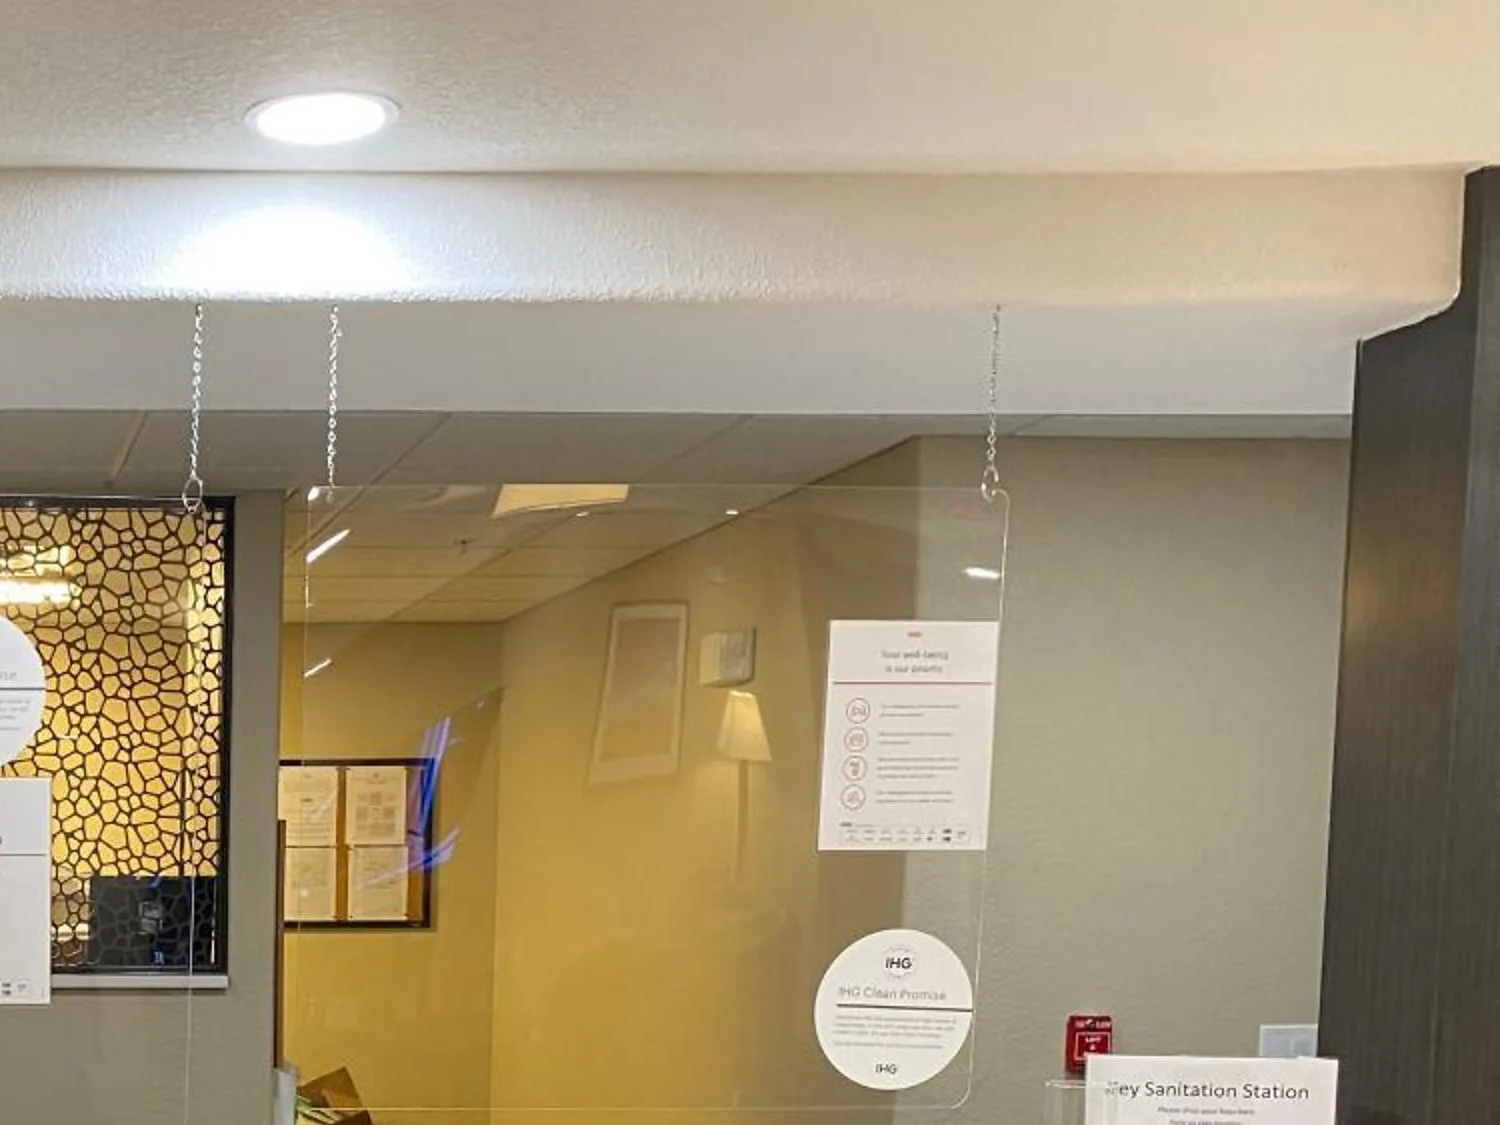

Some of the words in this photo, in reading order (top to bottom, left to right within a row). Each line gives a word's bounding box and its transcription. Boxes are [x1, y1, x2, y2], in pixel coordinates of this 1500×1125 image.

[885, 957, 912, 970] IHG
[837, 986, 861, 998] IHG
[863, 987, 898, 999] Clean
[900, 988, 946, 1000] Promise
[875, 1064, 898, 1075] IHG
[1145, 1081, 1238, 1099] Sanitation
[1242, 1083, 1310, 1100] Station
